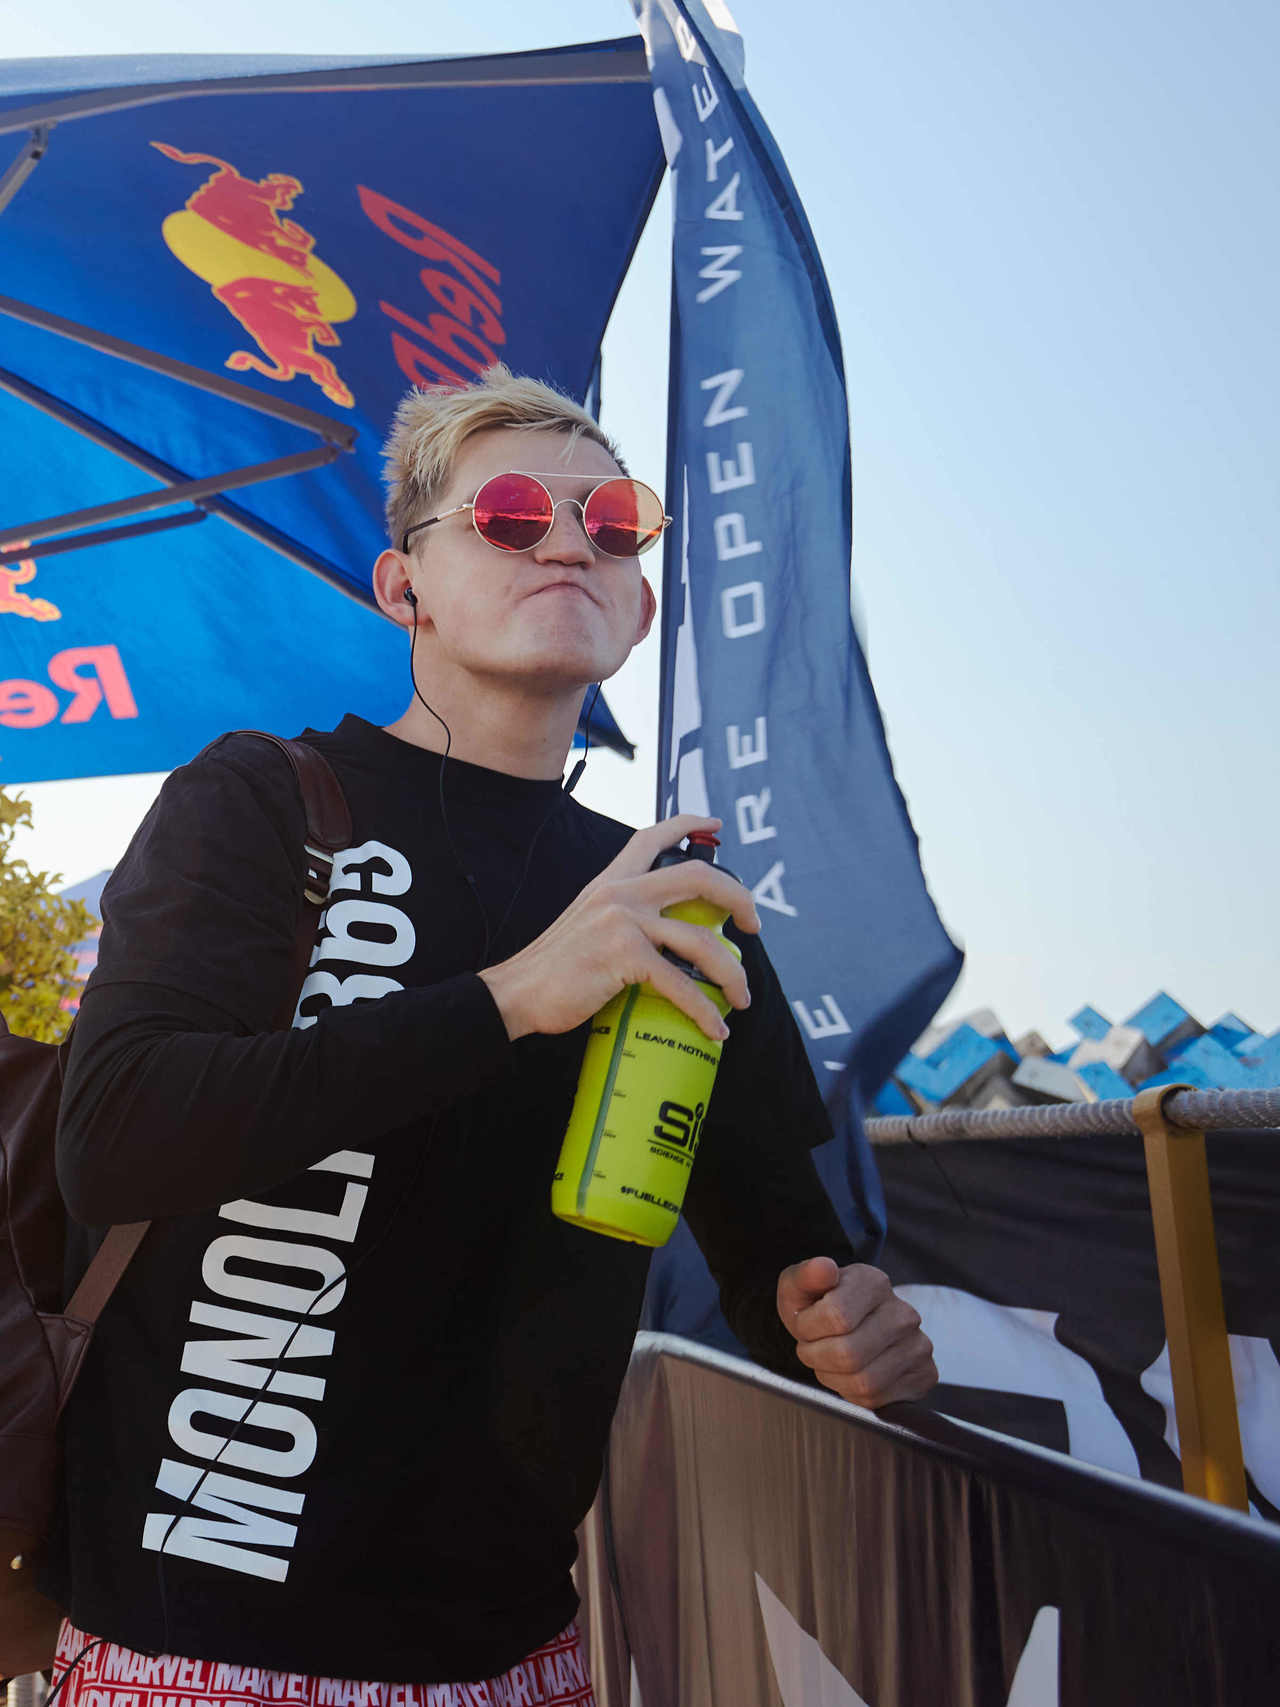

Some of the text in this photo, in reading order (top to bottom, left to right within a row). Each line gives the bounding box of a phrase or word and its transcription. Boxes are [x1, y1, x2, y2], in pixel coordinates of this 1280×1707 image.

[700, 368, 766, 639] OPEN
[725, 716, 799, 918] ARE
[634, 1031, 675, 1049] LEAVE
[102, 1642, 205, 1690] MARVEL
[214, 1662, 309, 1701] MARVEL
